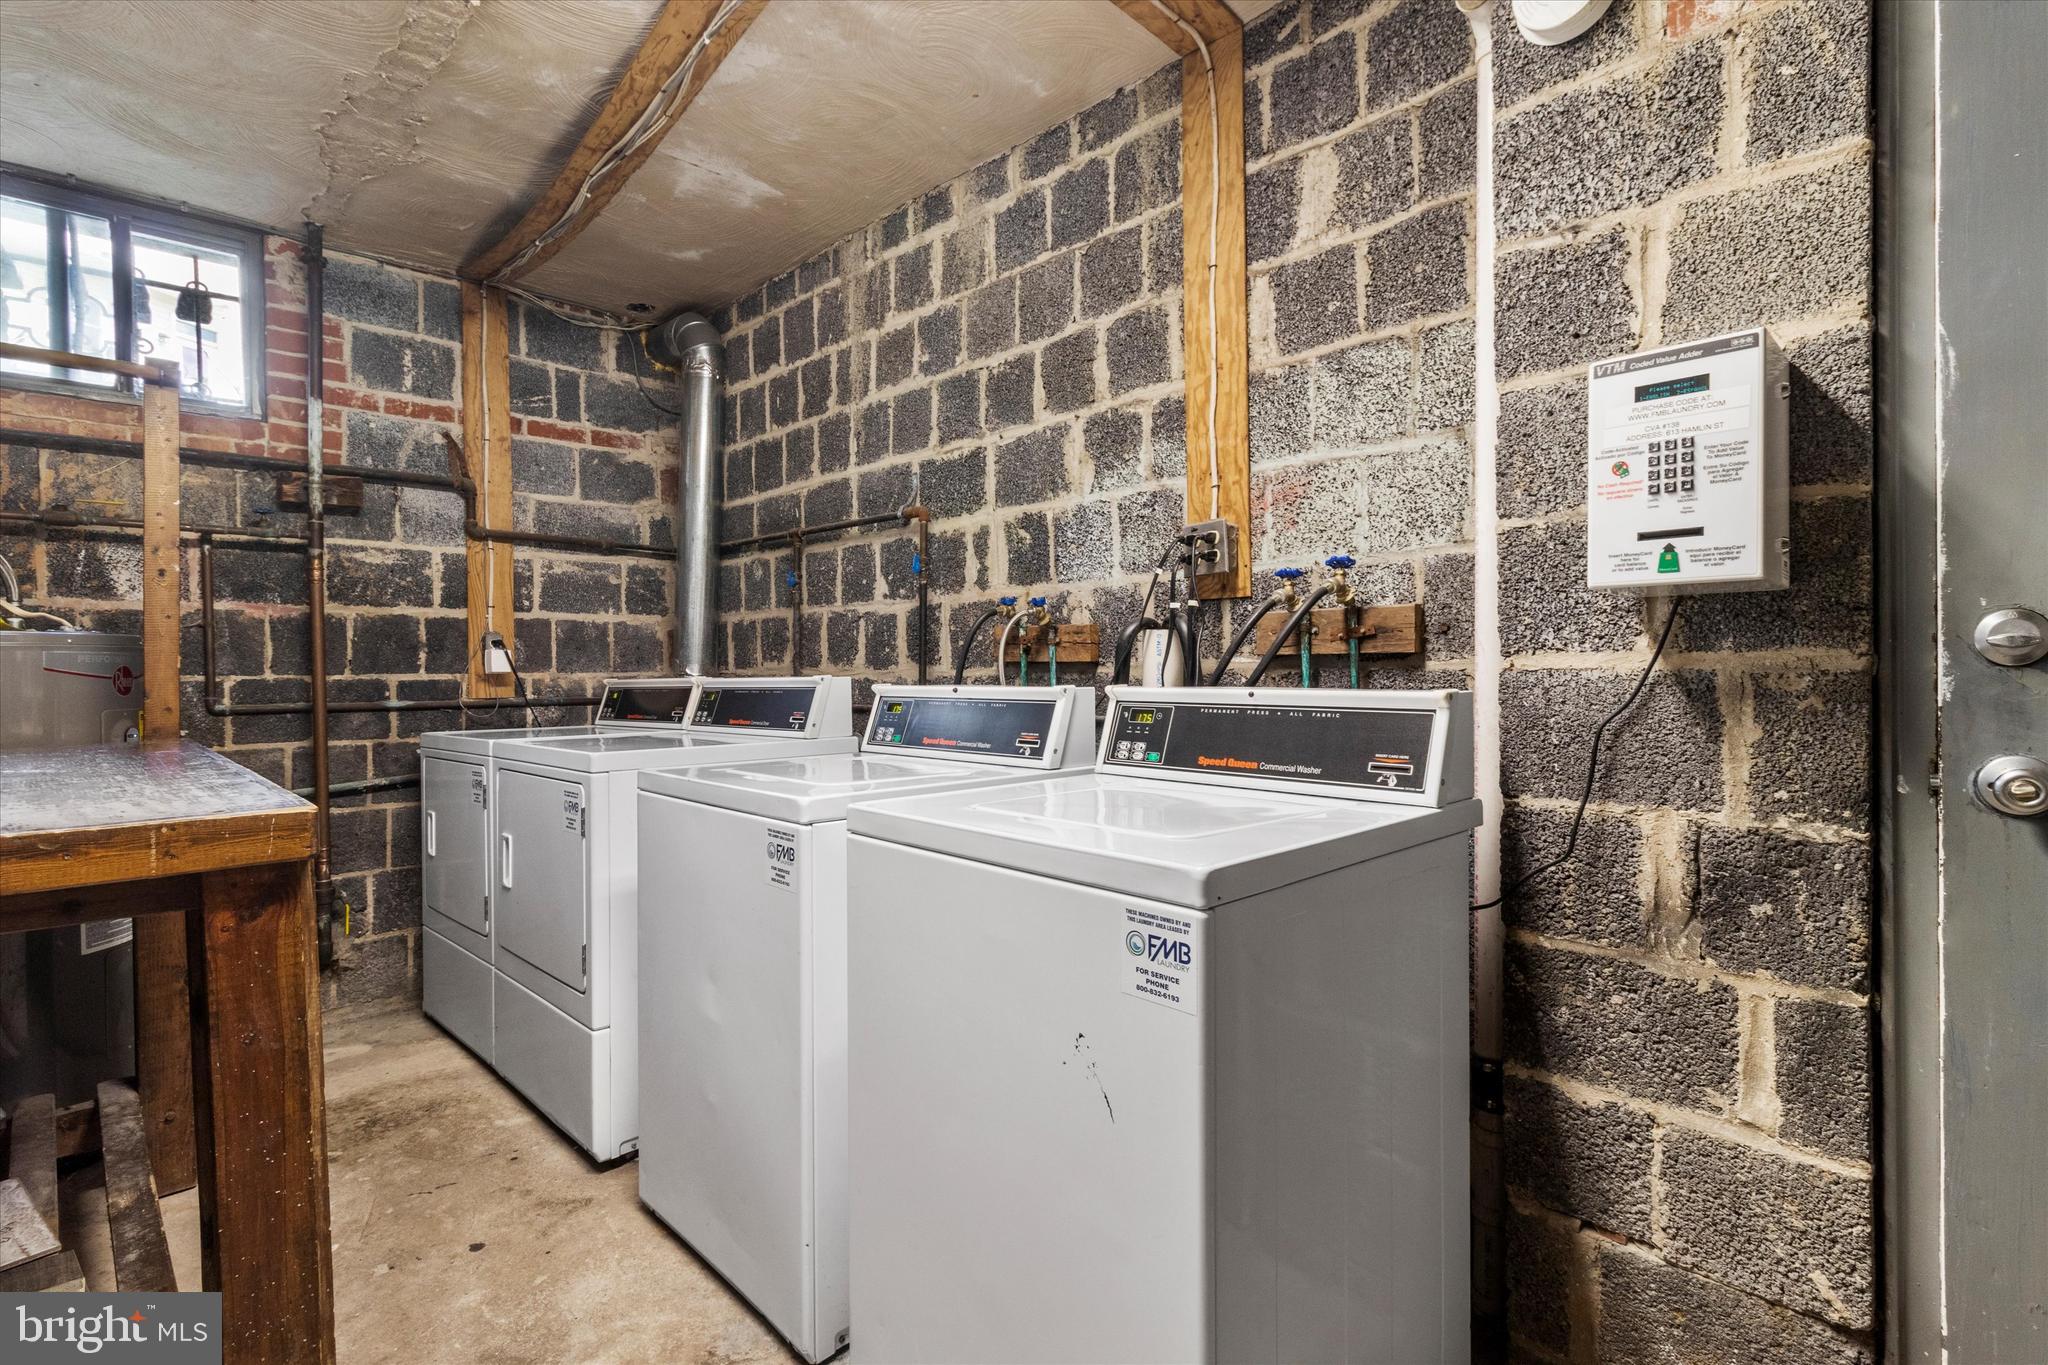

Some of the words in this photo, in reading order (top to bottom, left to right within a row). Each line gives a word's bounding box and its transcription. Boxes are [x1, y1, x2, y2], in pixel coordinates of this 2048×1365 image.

[1596, 361, 1626, 376] VTM
[1629, 357, 1655, 370] Coded
[1655, 353, 1677, 365] Value
[1678, 348, 1704, 360] Adder
[1632, 401, 1674, 413] PURCHASE
[1675, 396, 1698, 405] CODE
[1644, 424, 1661, 432] CVA
[1681, 423, 1712, 432] HAMLIN
[1713, 421, 1724, 429] ST
[1713, 544, 1746, 552] MoneyCard
[1311, 711, 1341, 719] FABRIC
[922, 736, 940, 745] Speed
[939, 737, 957, 746] Queen
[1198, 756, 1228, 767] Speed
[1227, 758, 1259, 769] Queen
[1259, 761, 1296, 773] Commercial
[1296, 765, 1322, 775] Washer
[776, 843, 795, 862] FMB
[1125, 907, 1138, 916] THESE
[1159, 915, 1174, 925] OWNED
[1182, 921, 1192, 929] AND
[1155, 922, 1166, 930] AREA
[1148, 933, 1191, 965] FMB
[1157, 958, 1191, 974] LAUNDRY
[1136, 966, 1150, 976] FOR
[1150, 970, 1180, 985] SERVICE
[1145, 978, 1169, 991] PHONE
[1136, 984, 1180, 1003] 800-832-6193
